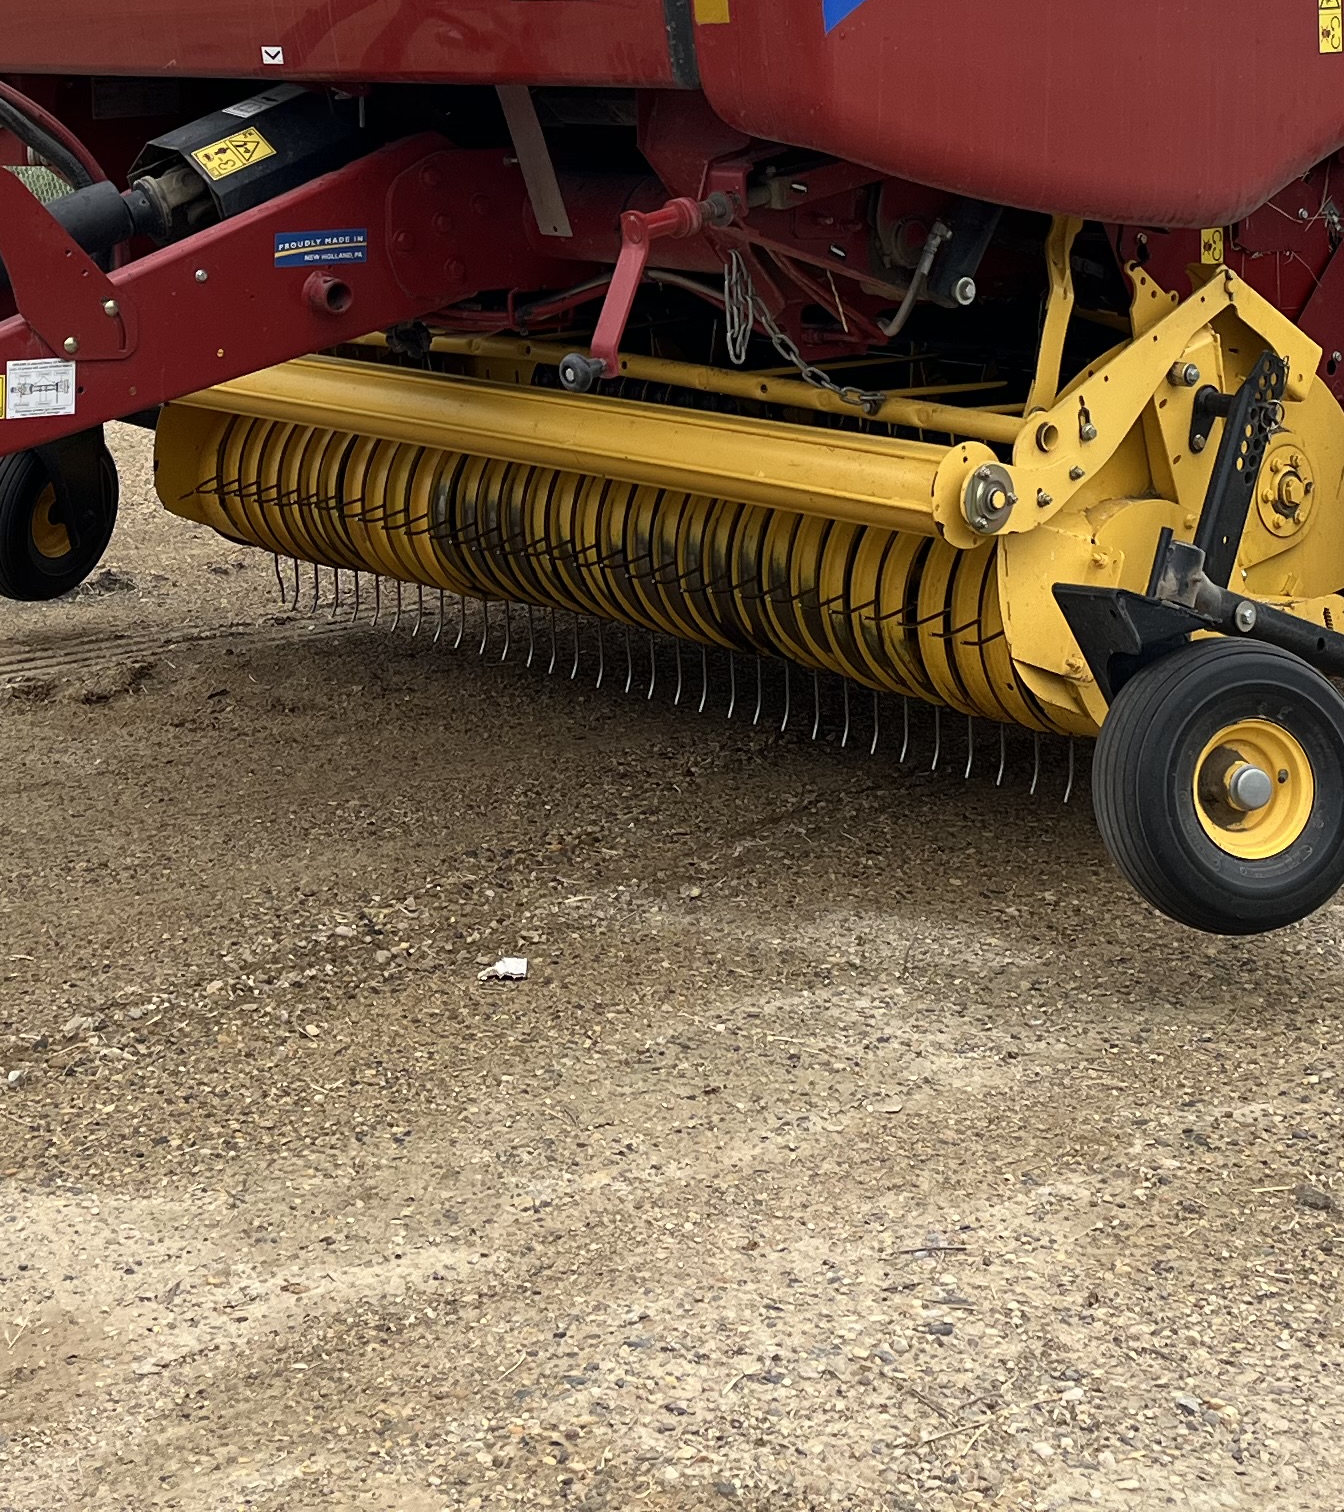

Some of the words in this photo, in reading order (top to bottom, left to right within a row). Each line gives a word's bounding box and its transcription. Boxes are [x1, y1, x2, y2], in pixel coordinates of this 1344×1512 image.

[278, 234, 321, 250] PROUDLY
[324, 235, 351, 245] MADE
[353, 235, 364, 243] IN
[304, 253, 320, 261] NEW
